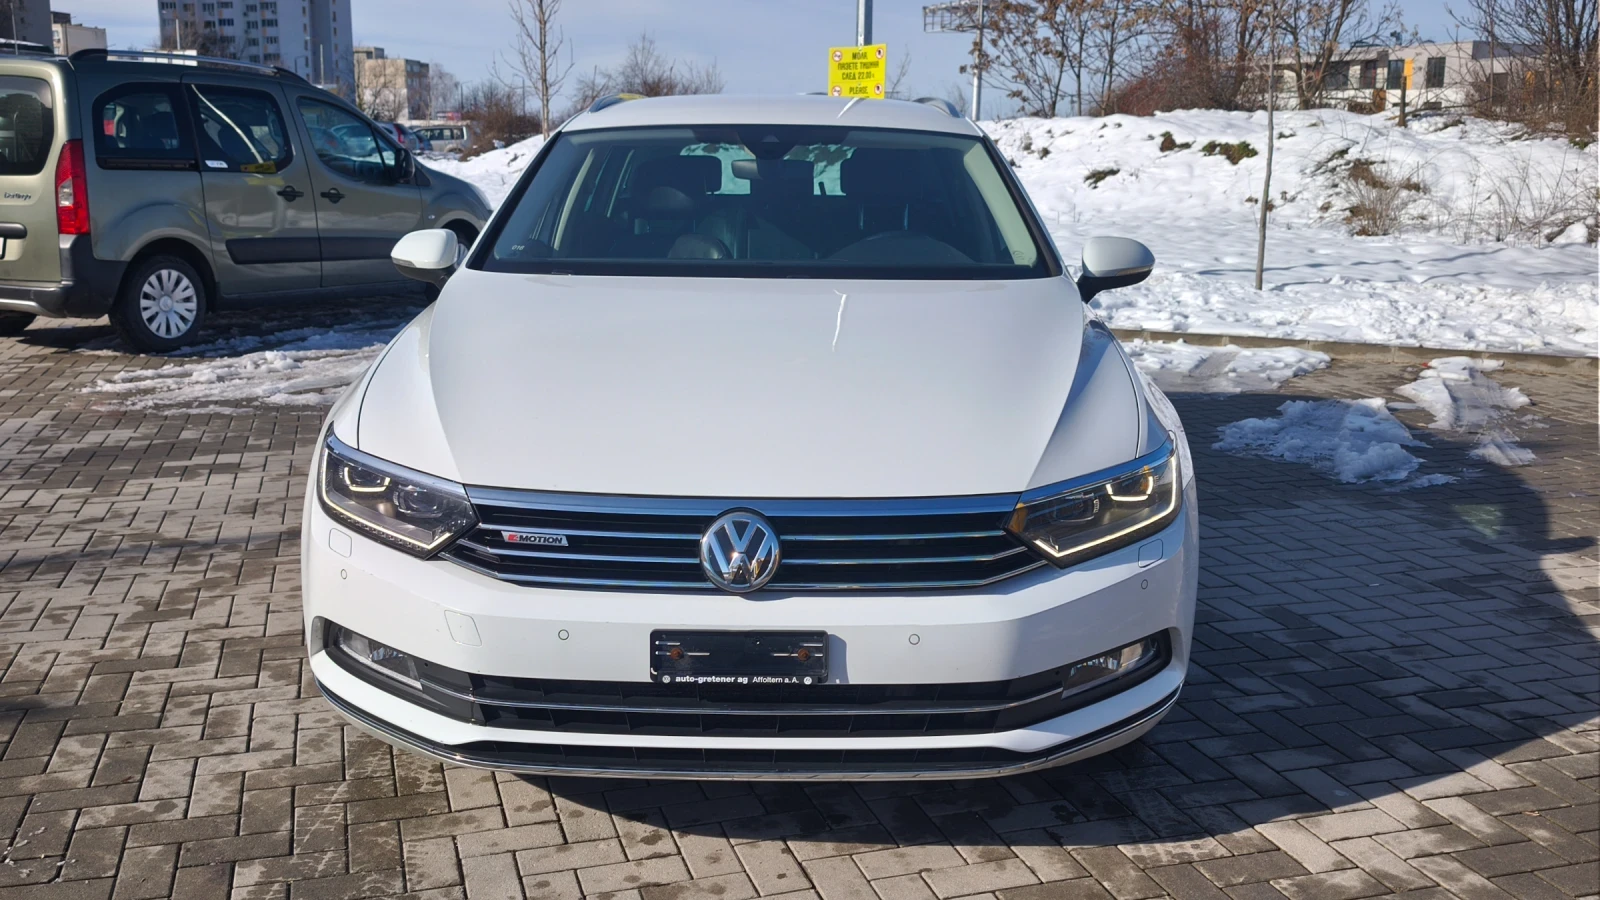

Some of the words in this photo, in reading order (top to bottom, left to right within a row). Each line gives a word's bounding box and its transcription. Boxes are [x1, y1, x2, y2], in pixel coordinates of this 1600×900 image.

[849, 86, 868, 94] PLEASE
[675, 675, 735, 684] auto-gretener
[737, 676, 748, 684] ag
[752, 676, 783, 684] Affoltern
